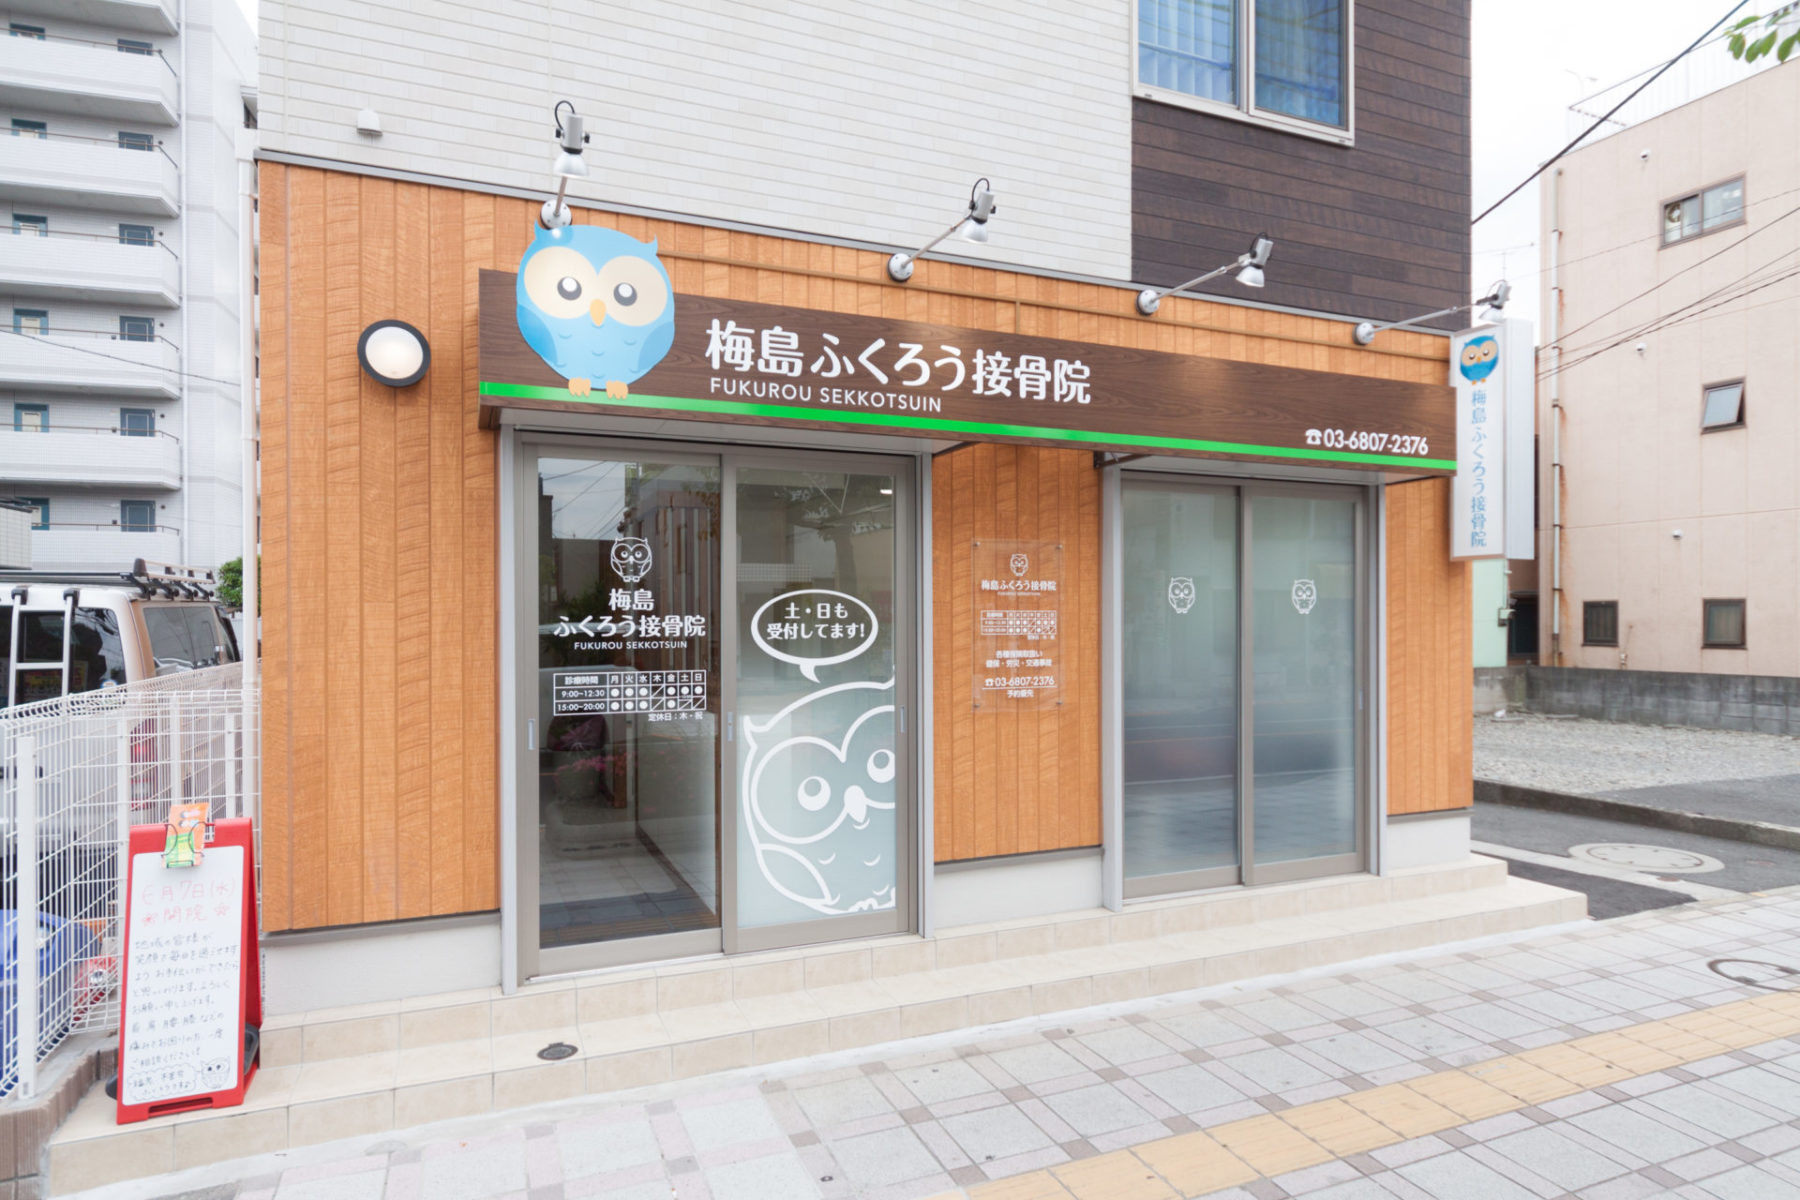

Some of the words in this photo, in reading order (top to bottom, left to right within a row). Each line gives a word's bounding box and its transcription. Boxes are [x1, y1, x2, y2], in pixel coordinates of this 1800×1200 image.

[705, 318, 1091, 404] 梅島ふくろう接骨院
[710, 377, 812, 401] FUKUROU
[820, 387, 941, 413] SEKKOTSUIN
[1323, 428, 1429, 456] 03-6807-2376
[1471, 389, 1487, 548] 梅島ふくろう接骨院
[608, 588, 655, 611] 梅島
[784, 601, 848, 619] 土・日も
[553, 614, 706, 638] ふくろう接骨院
[574, 642, 623, 650] FUKUROU
[626, 641, 688, 649] SEKKOTSUIN
[610, 675, 619, 684] 月
[625, 675, 634, 683] 火
[639, 675, 648, 683] 水
[653, 674, 662, 682] 木
[667, 674, 676, 682] 金
[681, 674, 689, 682] 土
[695, 673, 702, 681] 日
[994, 676, 1055, 686] 03-6807-2376
